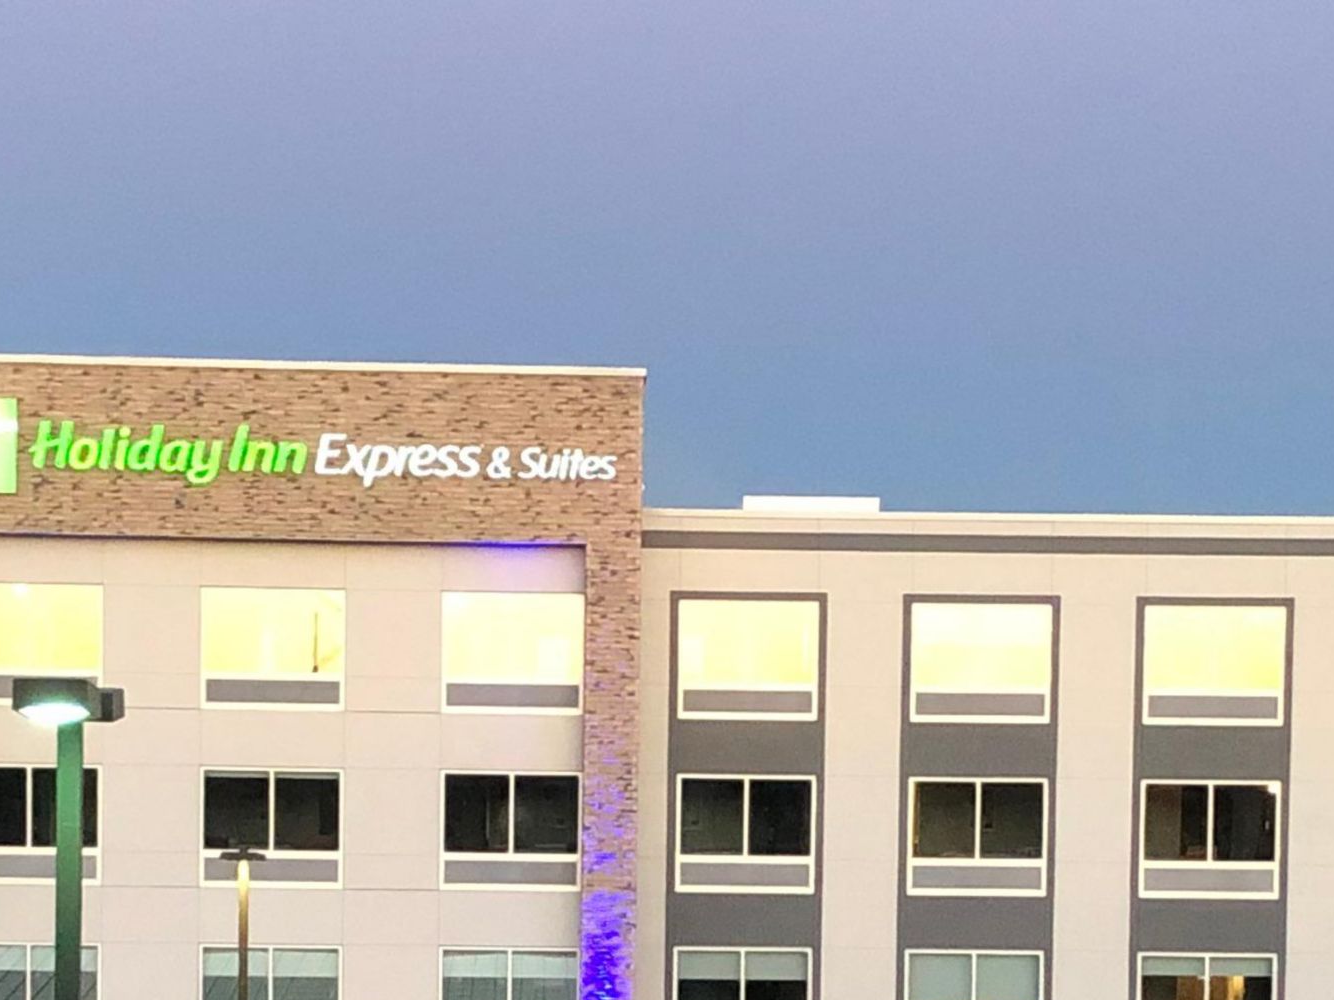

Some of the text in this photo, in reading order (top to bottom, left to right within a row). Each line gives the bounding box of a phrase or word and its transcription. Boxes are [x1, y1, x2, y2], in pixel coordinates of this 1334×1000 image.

[28, 420, 224, 485] Holiday
[228, 422, 308, 474] Inn
[314, 432, 482, 488] Express
[486, 446, 512, 479] &
[518, 446, 617, 480] Suites
